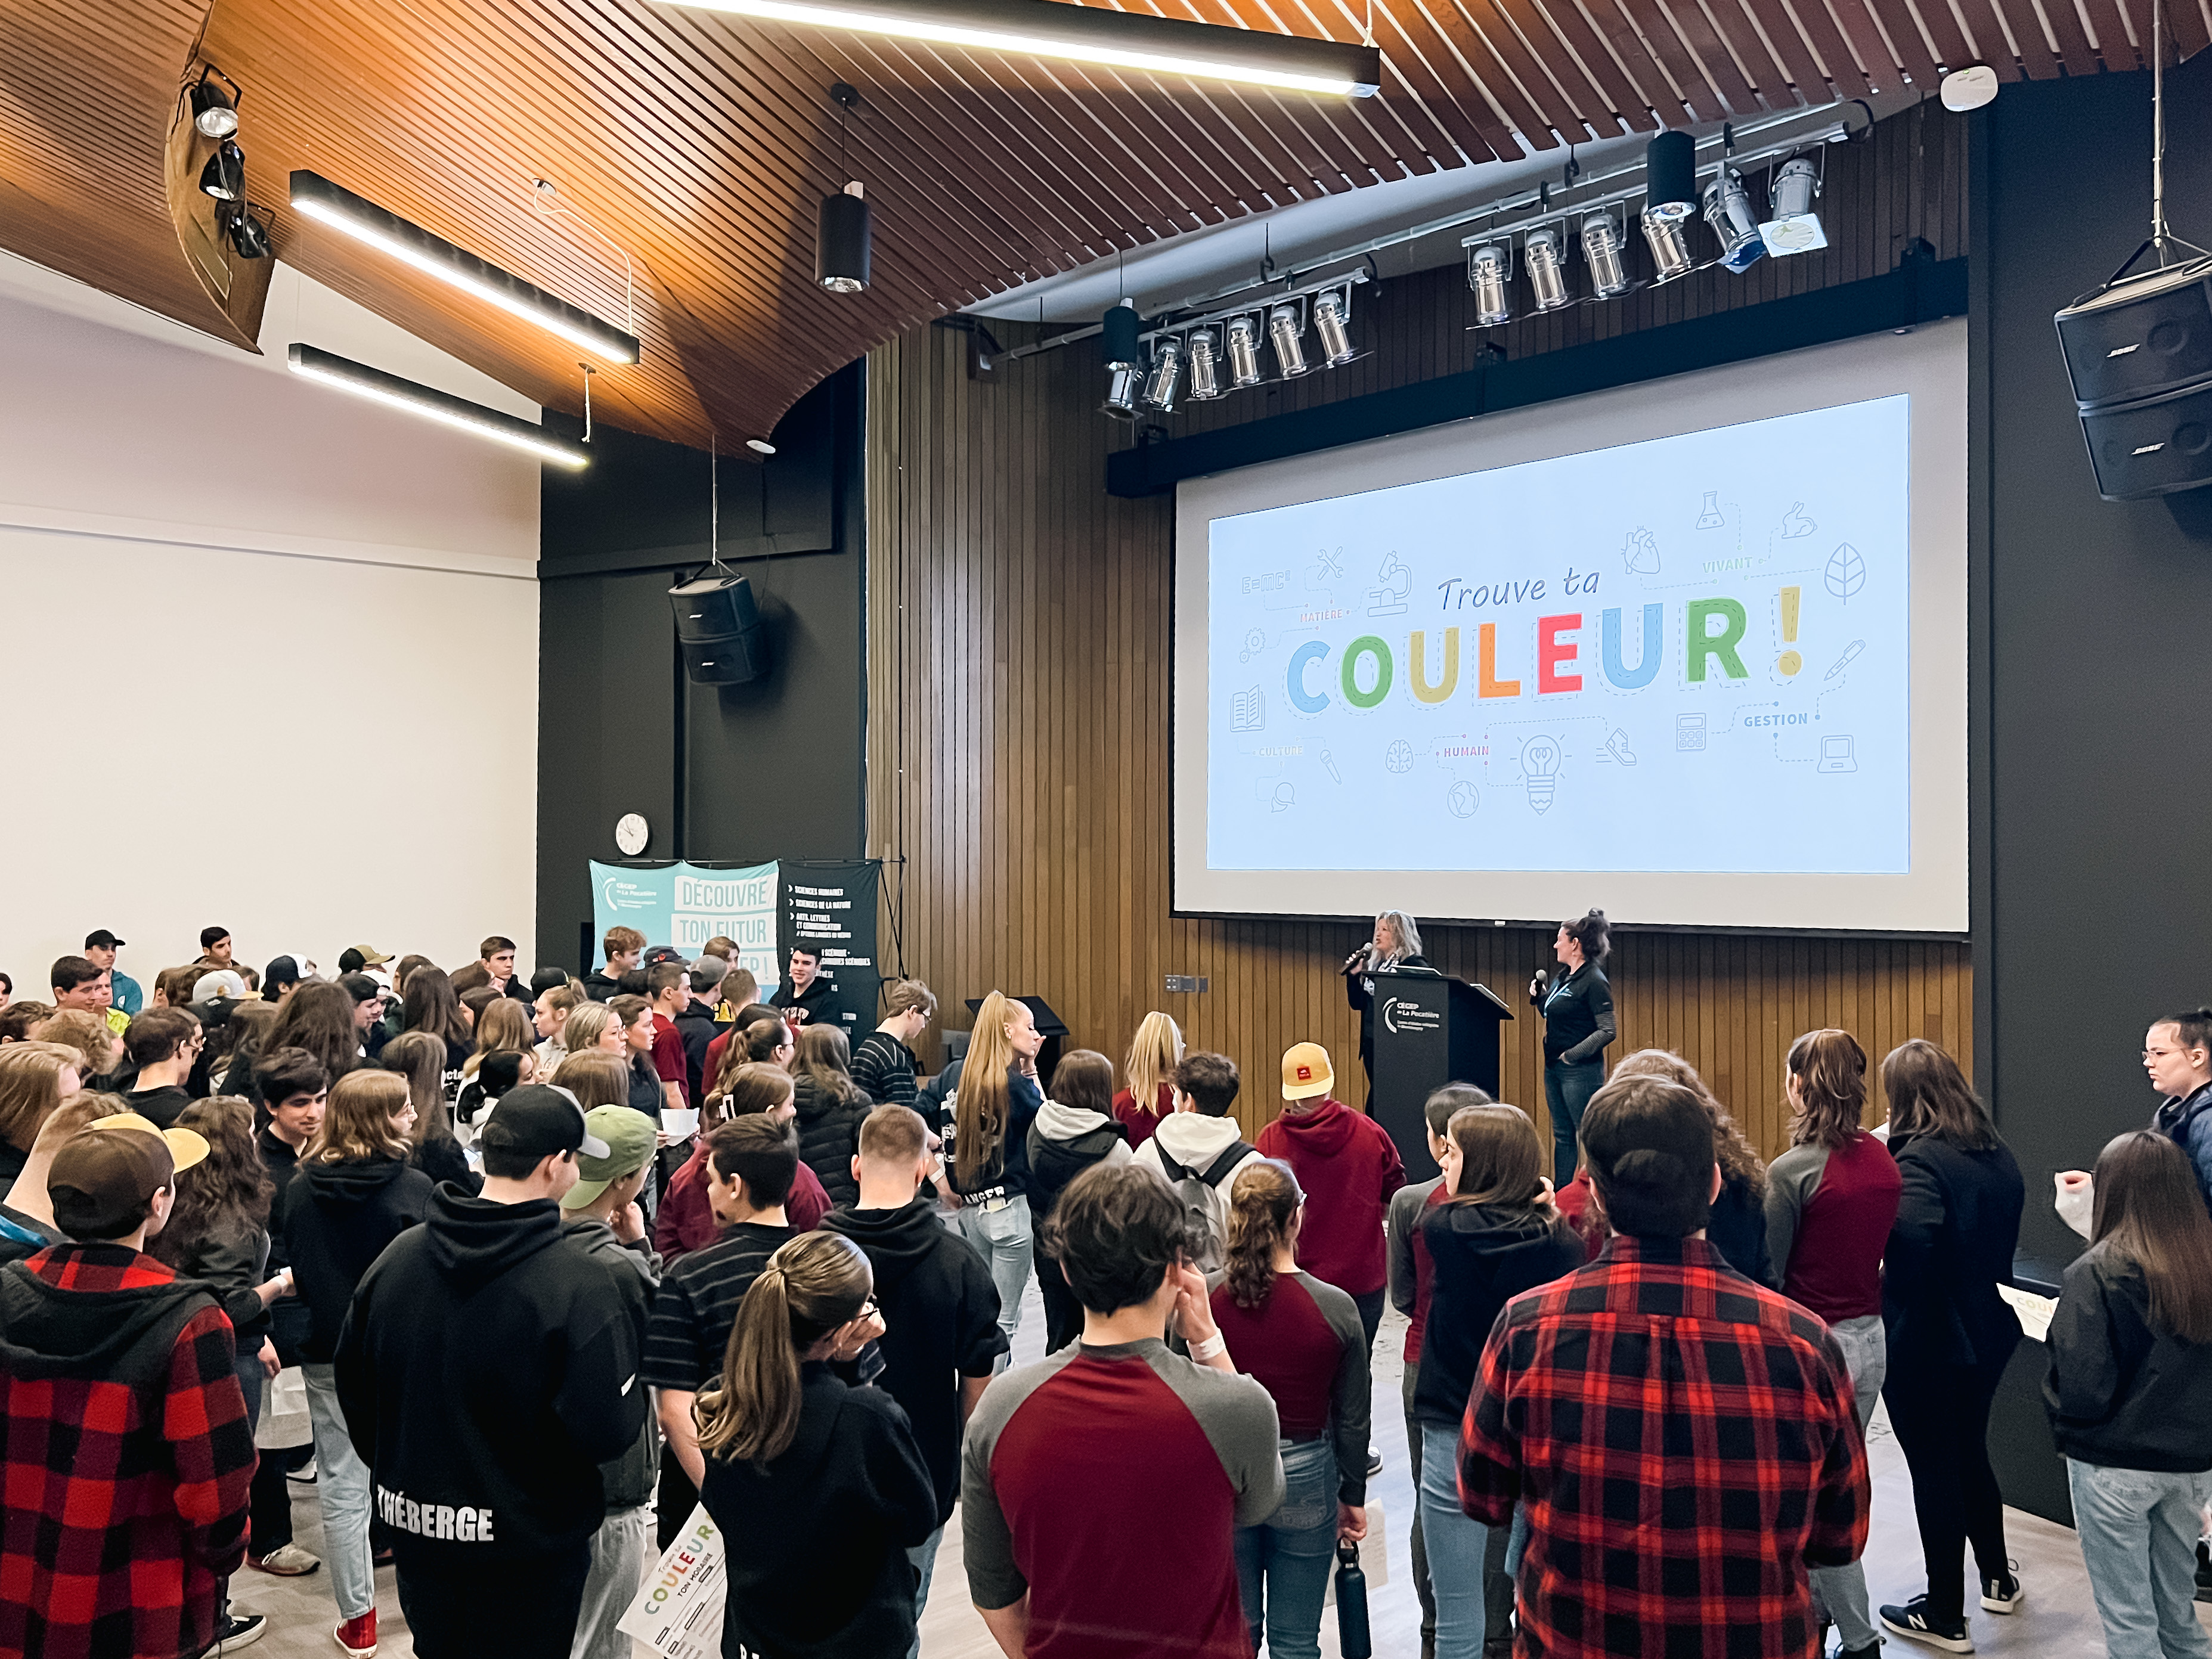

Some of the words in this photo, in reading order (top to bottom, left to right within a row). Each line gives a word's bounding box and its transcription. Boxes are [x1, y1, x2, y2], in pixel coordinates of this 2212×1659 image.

[1702, 556, 1753, 573] VIVANT
[1438, 578, 1546, 610] Trouve
[1563, 568, 1600, 596] ta
[1300, 609, 1343, 623] MATIÈRE
[1743, 713, 1808, 727] GESTION
[1259, 746, 1303, 756] CULTURE
[1443, 746, 1489, 757] HUMAIN
[683, 879, 768, 907] DÉCOUVRE
[680, 919, 710, 943] TON
[716, 919, 767, 943] FUTUR
[377, 1484, 494, 1542] THÉBERGE
